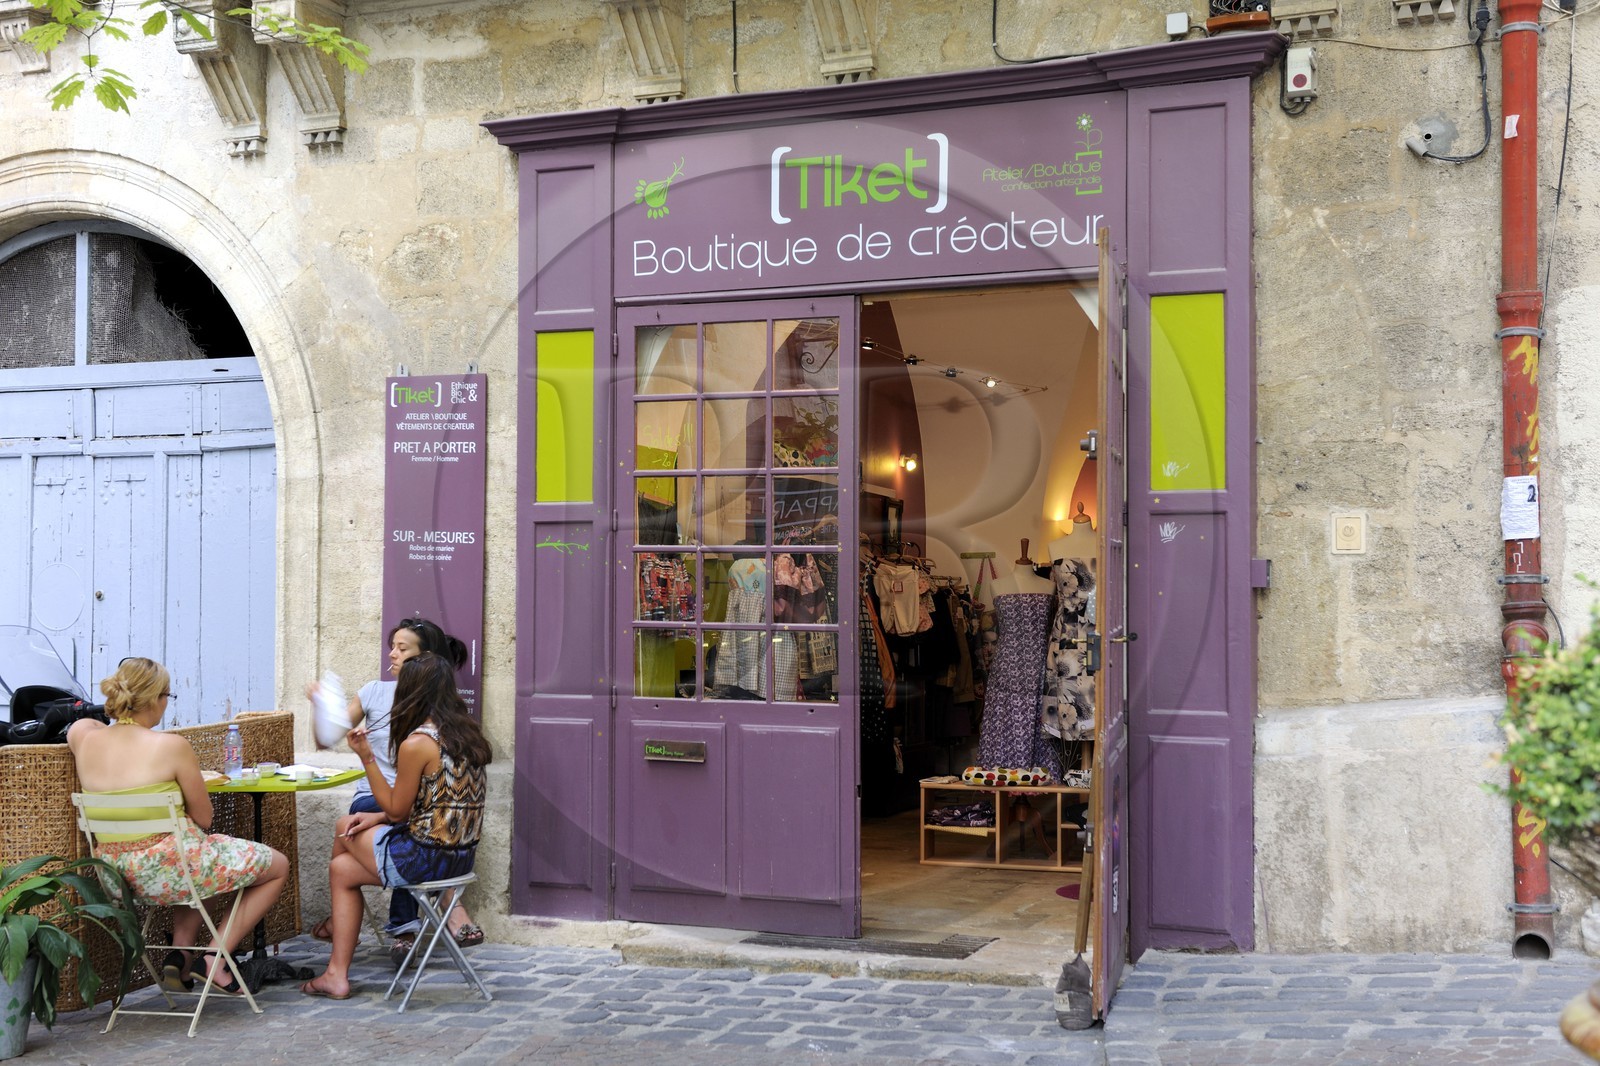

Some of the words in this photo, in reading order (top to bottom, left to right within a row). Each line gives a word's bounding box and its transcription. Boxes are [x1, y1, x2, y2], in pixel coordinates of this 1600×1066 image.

[1001, 180, 1053, 192] confection
[633, 233, 818, 278] Boutique
[836, 223, 892, 262] de
[908, 211, 1105, 257] créateur
[433, 422, 442, 430] DE
[394, 442, 421, 453] PRET
[422, 441, 431, 454] A
[434, 442, 476, 453] PORTER
[392, 530, 415, 542] SUR
[423, 531, 475, 544] MESURES
[426, 544, 435, 552] de
